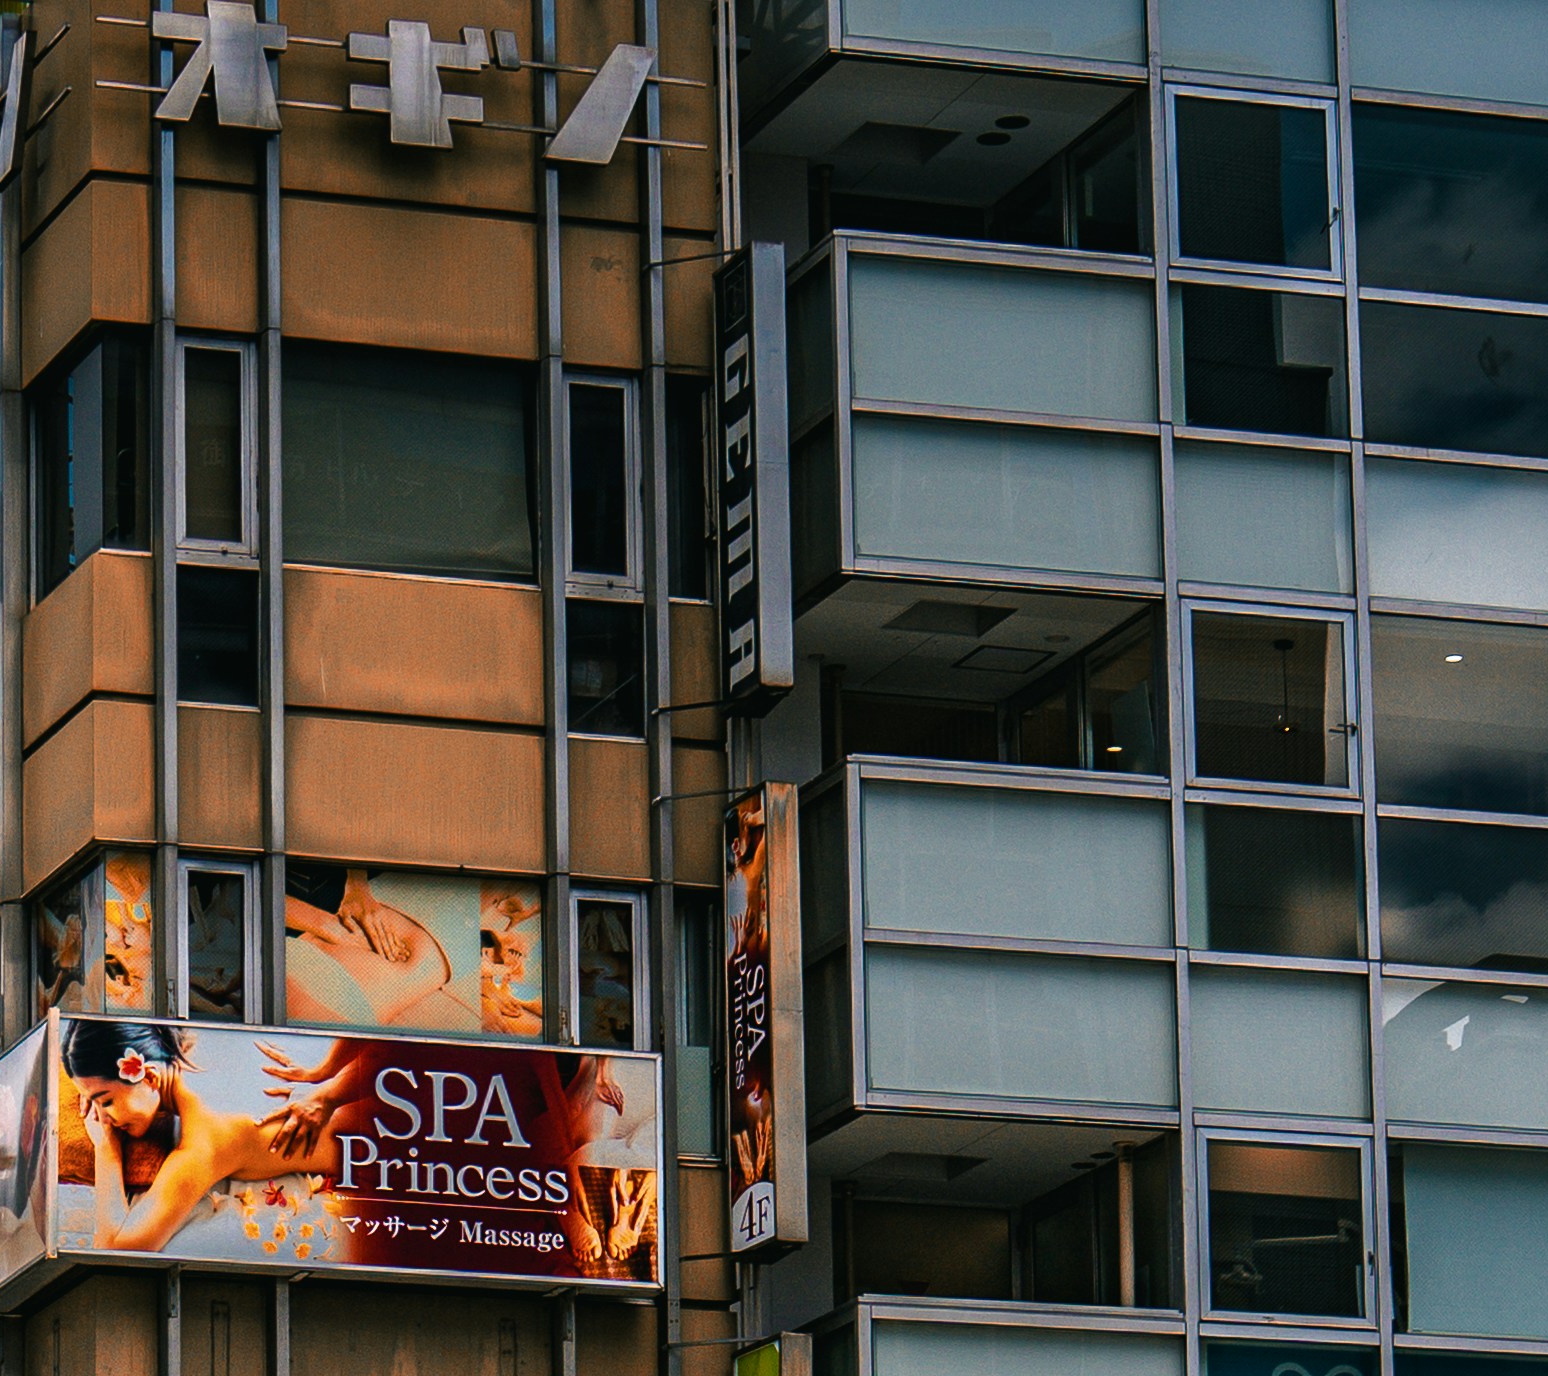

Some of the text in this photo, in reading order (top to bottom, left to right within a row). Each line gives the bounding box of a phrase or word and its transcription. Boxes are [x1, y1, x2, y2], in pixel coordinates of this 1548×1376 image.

[152, 0, 656, 164] オギノ
[733, 952, 748, 1090] Princess
[746, 963, 767, 1062] SPA
[373, 1066, 532, 1147] SPA
[337, 1136, 569, 1205] Princess
[338, 1212, 566, 1254] マッサージ Massage
[738, 1190, 770, 1244] 4F
